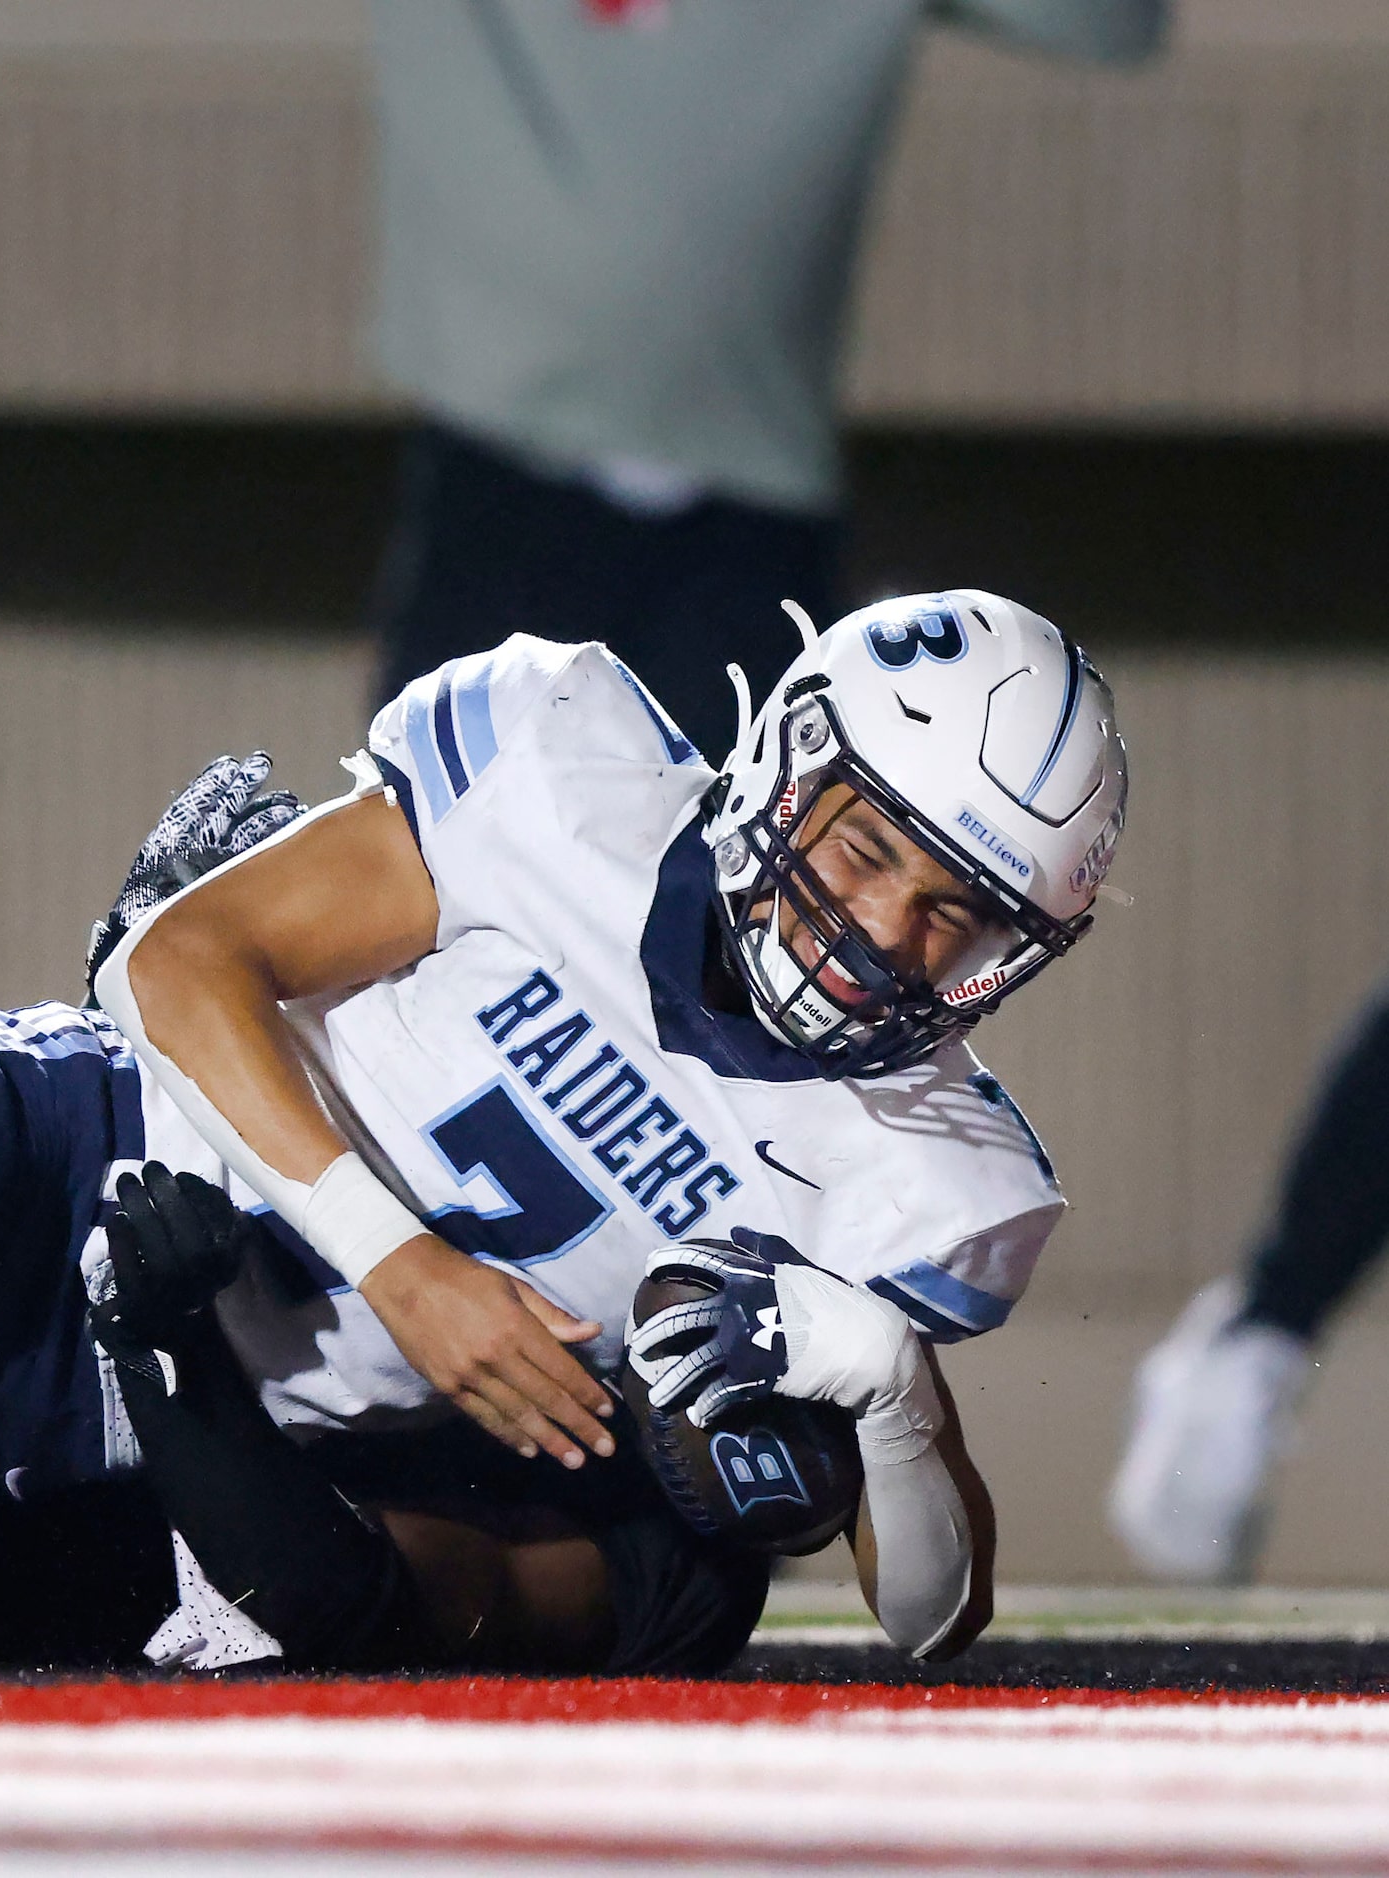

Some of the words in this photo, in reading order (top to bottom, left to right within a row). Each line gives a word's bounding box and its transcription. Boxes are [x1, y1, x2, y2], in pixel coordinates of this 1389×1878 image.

[860, 595, 969, 672] B
[954, 808, 1030, 877] BELLieve
[798, 996, 832, 1027] iddell
[473, 967, 743, 1239] RAIDERS
[710, 1430, 813, 1517] B
